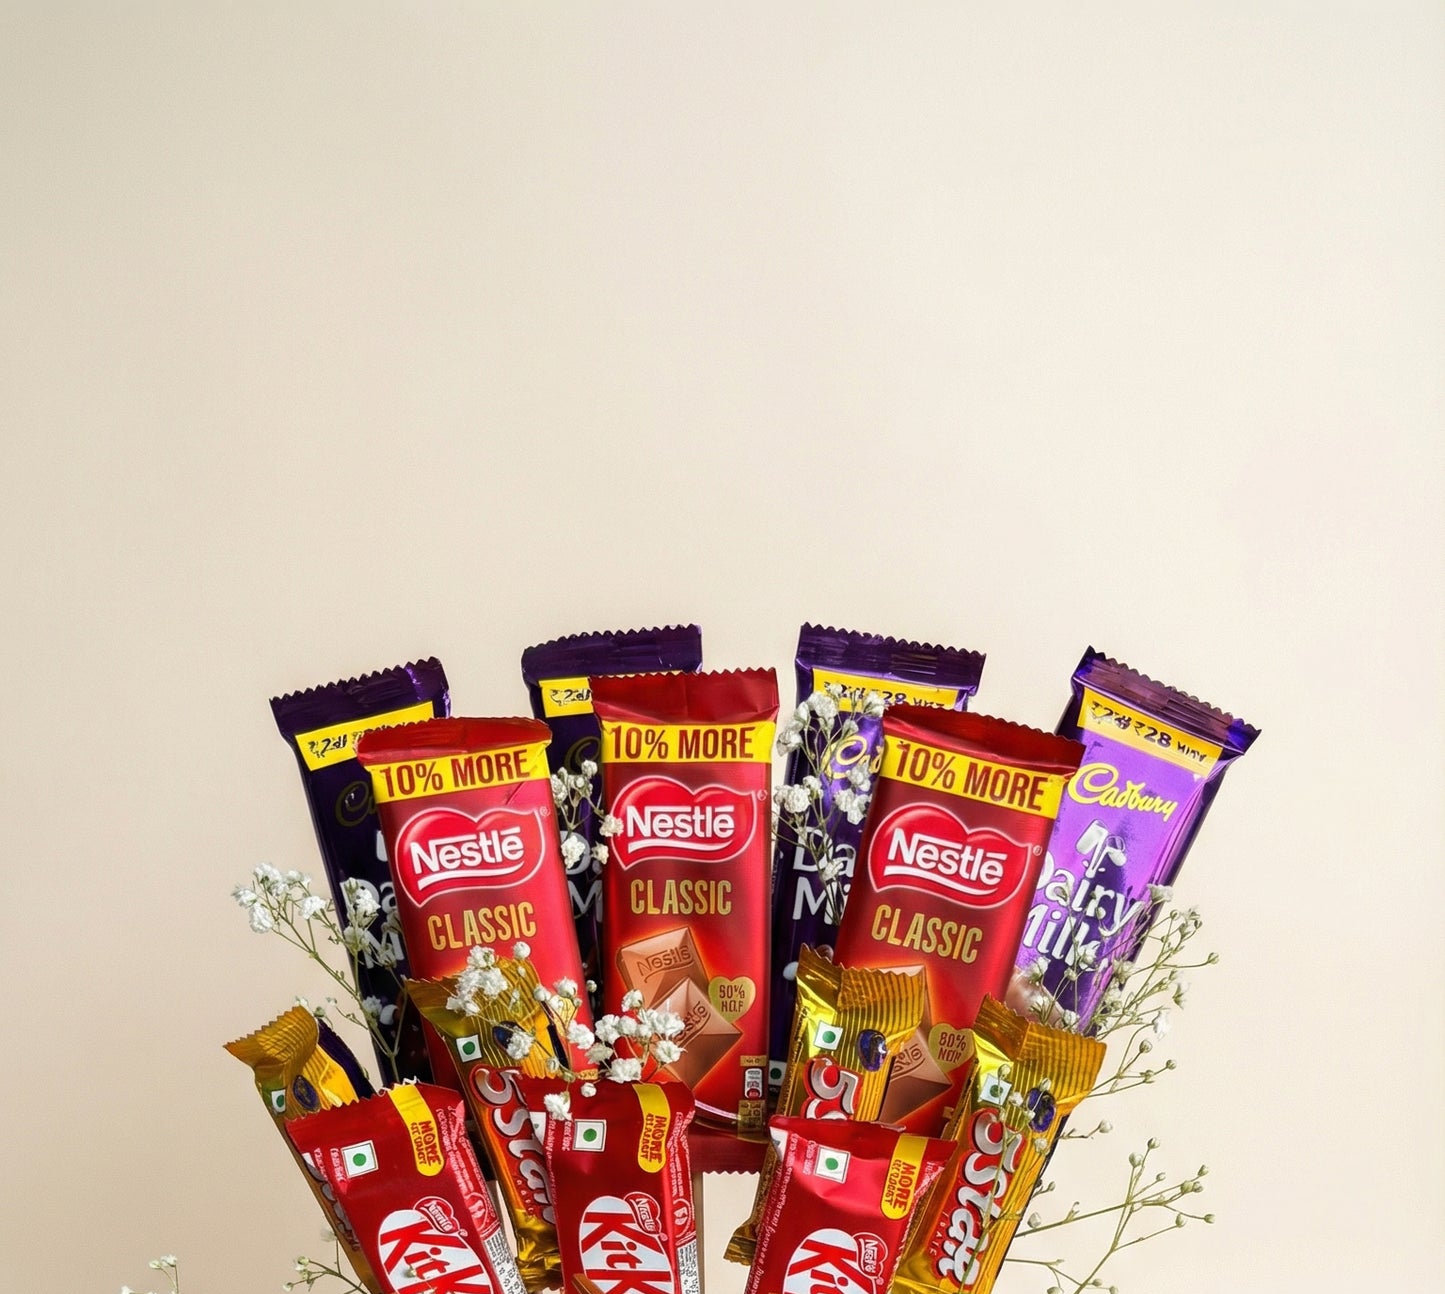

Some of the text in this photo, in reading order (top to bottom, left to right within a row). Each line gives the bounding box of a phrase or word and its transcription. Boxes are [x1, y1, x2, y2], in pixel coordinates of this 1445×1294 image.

[612, 726, 669, 760] 10%
[678, 726, 754, 760] MORE
[379, 762, 444, 798] 10%
[452, 749, 530, 788] MORE
[895, 743, 956, 789] 10%
[965, 762, 1051, 812] MORE
[1067, 762, 1178, 822] Cadbury
[630, 879, 732, 916] CLASSIC
[427, 901, 537, 951] CLASSIC
[871, 904, 984, 964] CLASSIC
